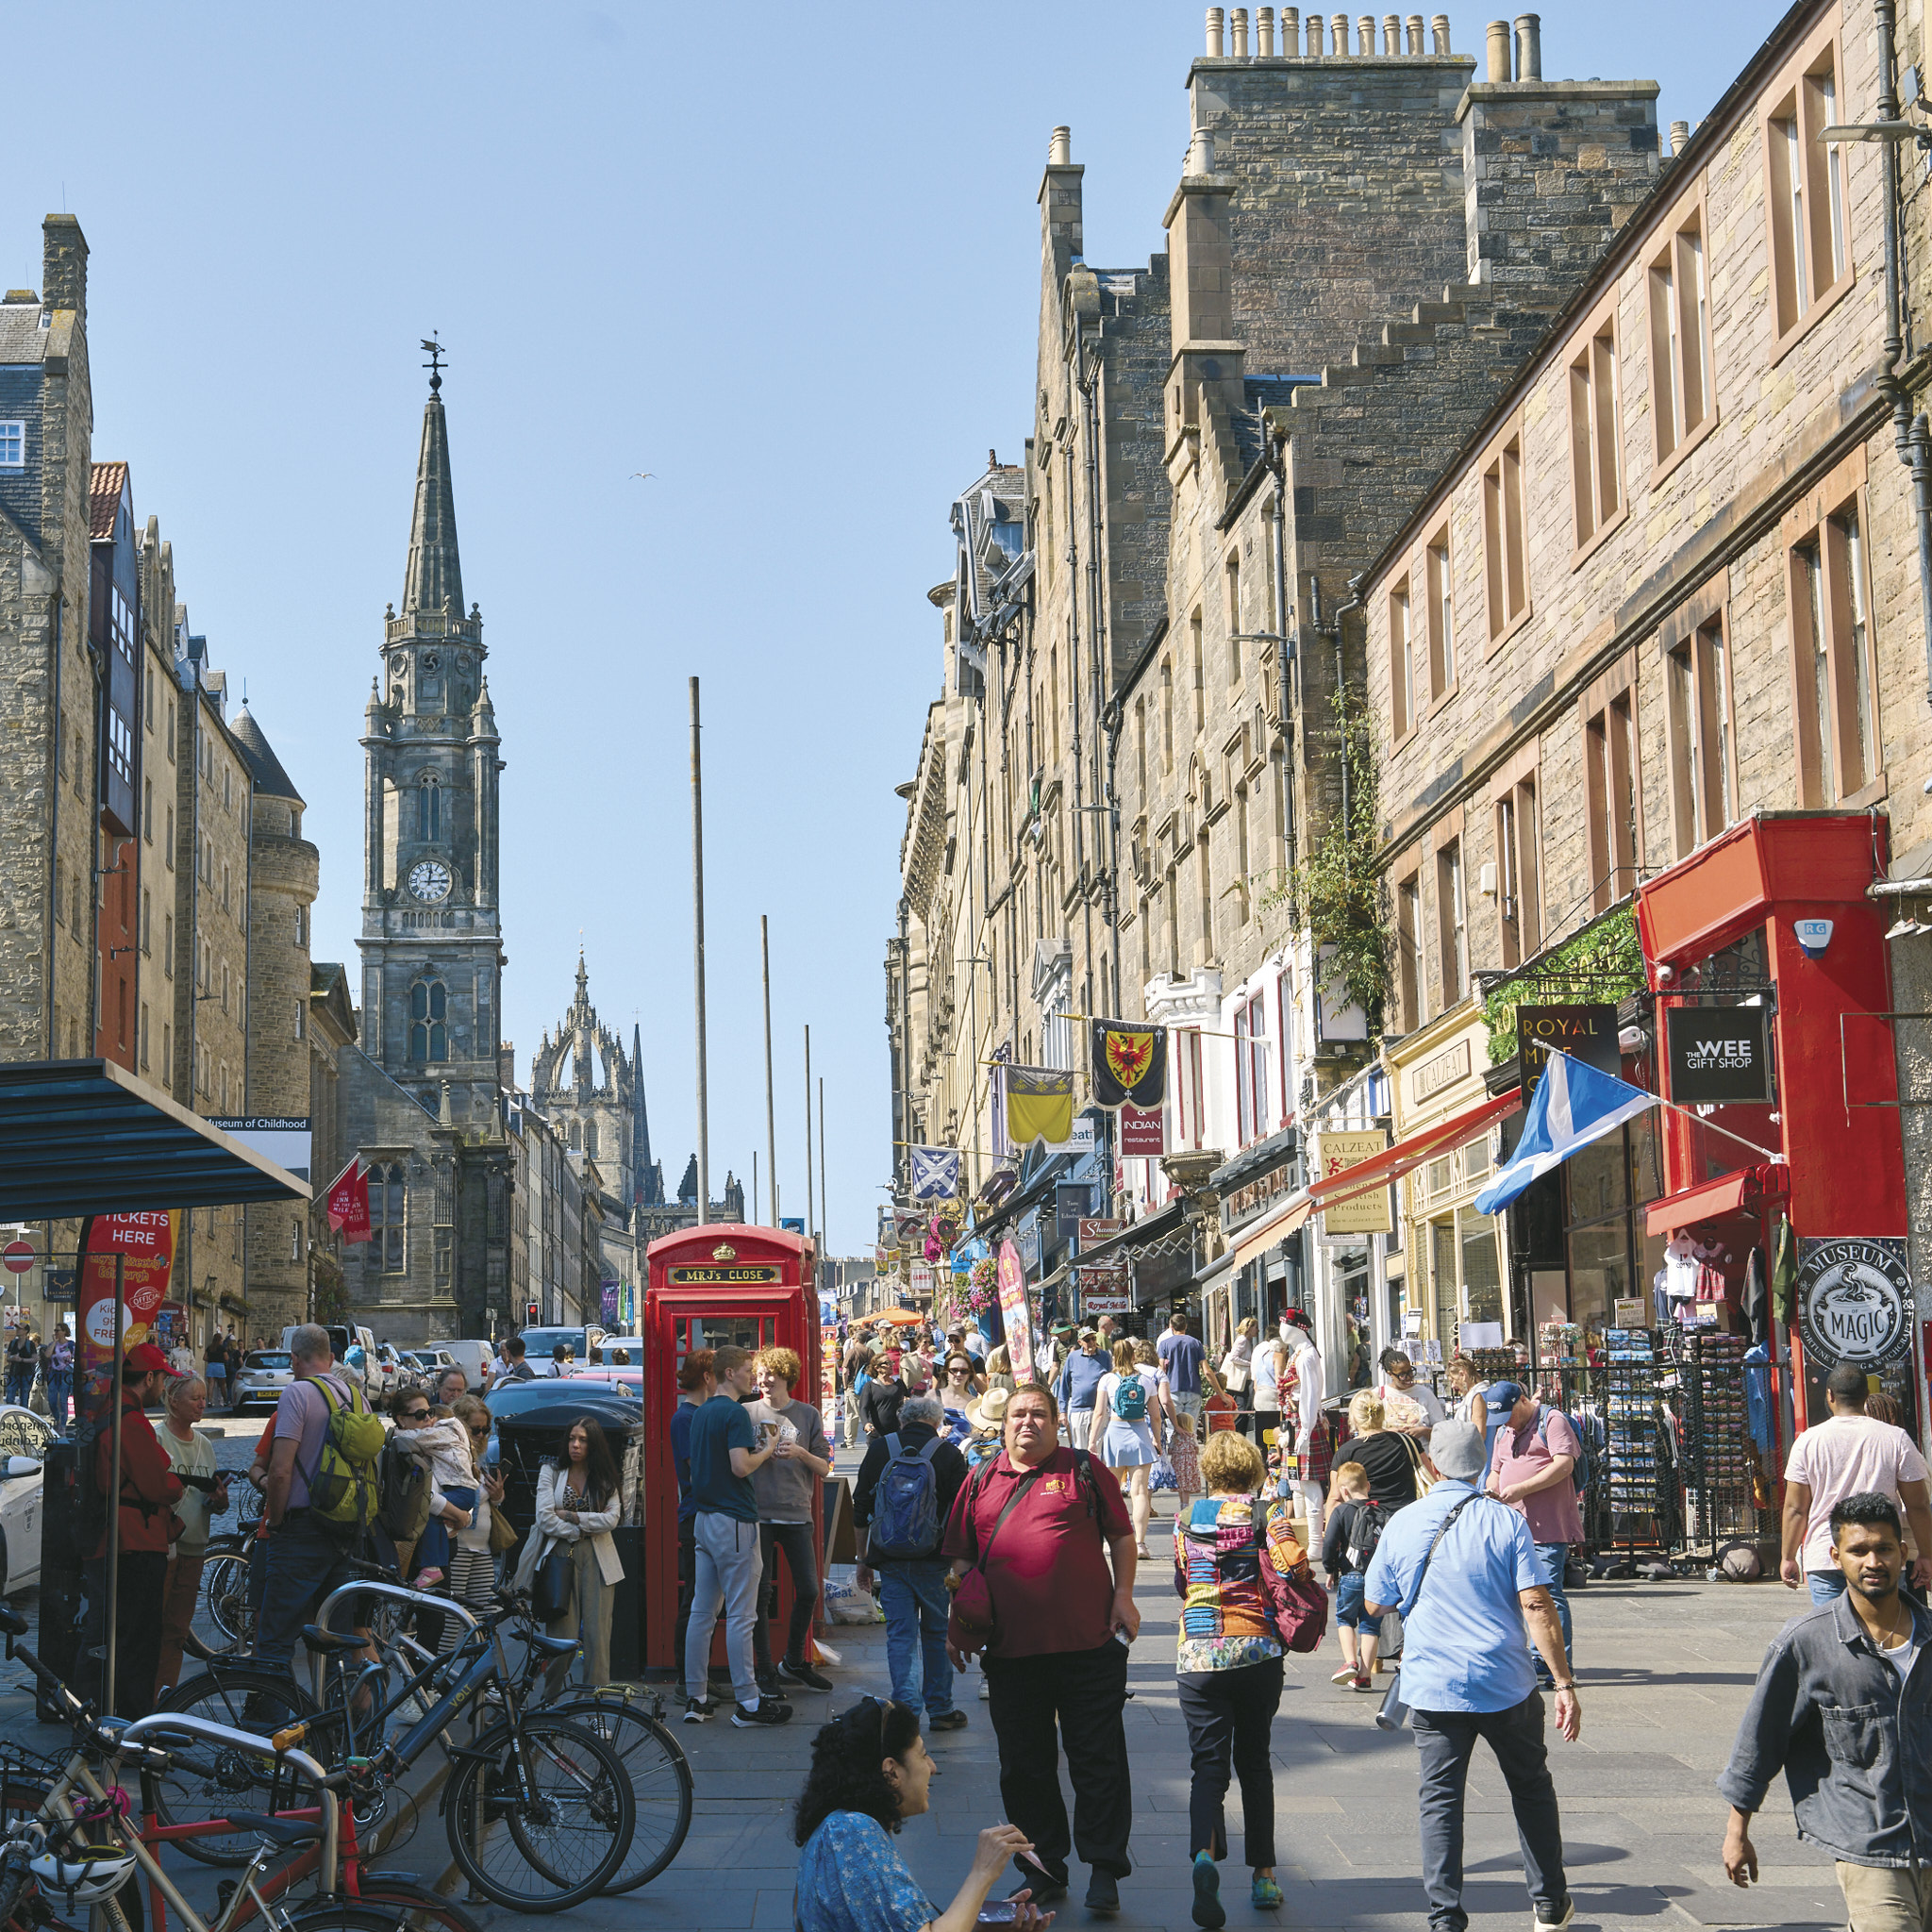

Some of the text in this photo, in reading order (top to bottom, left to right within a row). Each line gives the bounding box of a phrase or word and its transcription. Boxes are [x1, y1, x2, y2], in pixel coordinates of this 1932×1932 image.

[1523, 1018, 1599, 1037] ROYAL
[1524, 1046, 1573, 1064] MIE
[1695, 1040, 1753, 1058] WEE
[1687, 1058, 1753, 1069] GIFT SHOP
[245, 1118, 256, 1128] of
[258, 1119, 307, 1128] Childhood
[1124, 1121, 1161, 1130] INDIAN
[1324, 1141, 1382, 1154] CALZEAT
[1333, 1203, 1382, 1212] Products
[112, 1229, 156, 1245] HERE
[1807, 1244, 1894, 1274] MUSEUM
[98, 1265, 150, 1283] Edurgh
[728, 1270, 764, 1280] CLOSE
[133, 1291, 161, 1307] OFFICIAL
[1087, 1301, 1127, 1311] Royal Mile
[93, 1328, 116, 1339] FRE
[1830, 1309, 1885, 1344] MAGIC
[1801, 1324, 1835, 1365] FORTUNE
[448, 1683, 473, 1708] VOLT
